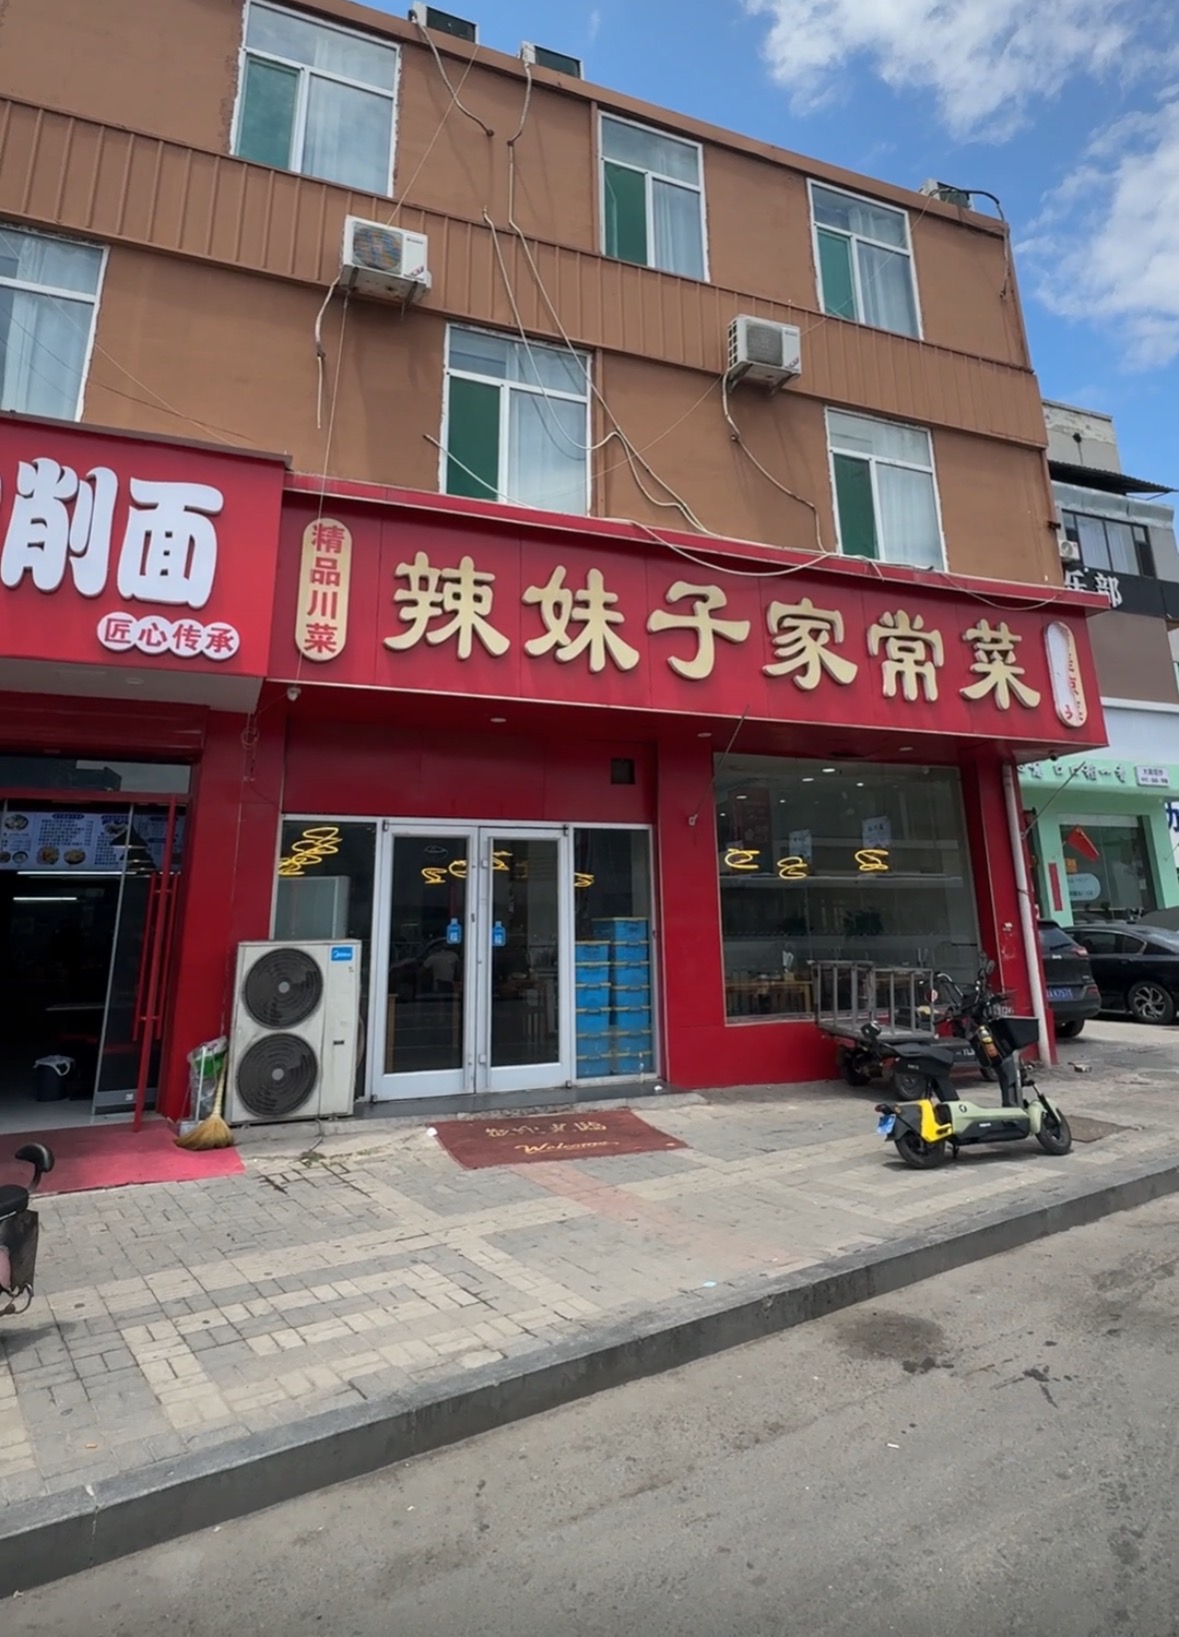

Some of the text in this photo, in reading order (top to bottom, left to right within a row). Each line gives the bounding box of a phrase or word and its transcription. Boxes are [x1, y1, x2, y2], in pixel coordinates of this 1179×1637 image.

[0, 457, 225, 609] 削面
[304, 523, 345, 653] 精品川菜
[104, 617, 234, 653] 匠心传承
[384, 550, 1041, 709] 辣妹子家常菜
